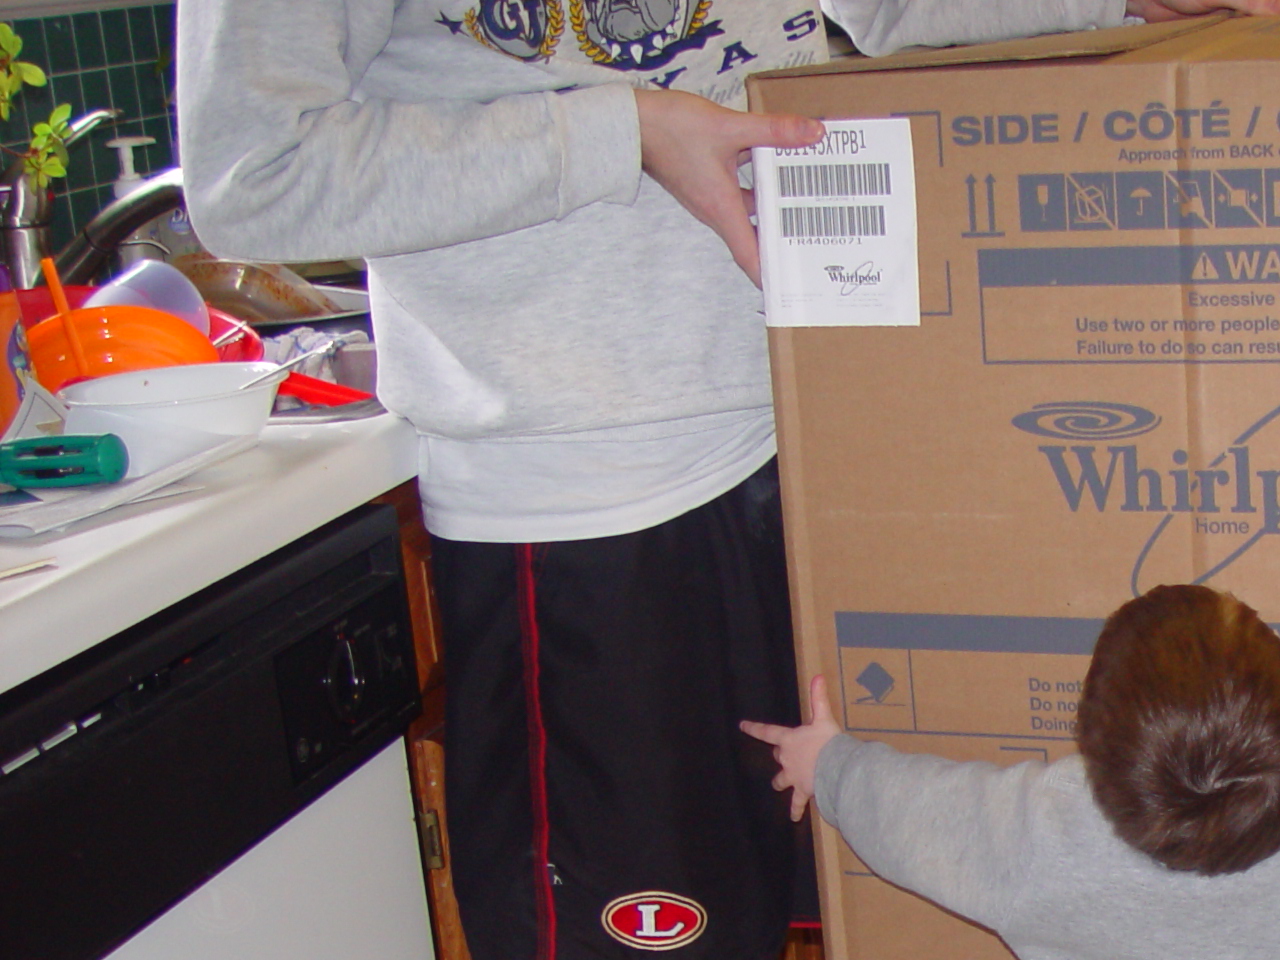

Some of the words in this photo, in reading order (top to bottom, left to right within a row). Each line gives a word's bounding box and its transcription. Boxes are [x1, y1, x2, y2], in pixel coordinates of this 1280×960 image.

[952, 113, 1059, 147] SIDE
[1073, 111, 1089, 142] /
[1103, 101, 1231, 142] CÔTÉ
[1246, 106, 1261, 138] /
[1118, 147, 1186, 163] Approach
[1192, 145, 1225, 160] from
[1230, 144, 1274, 159] BACK
[1188, 291, 1275, 307] Excessive
[1075, 317, 1108, 332] Use
[1113, 317, 1144, 332] two
[1150, 320, 1169, 332] or
[1173, 319, 1215, 331] more
[1221, 316, 1280, 334] people
[1077, 339, 1134, 355] Failure
[1138, 340, 1155, 355] to
[1161, 339, 1183, 355] do
[1187, 341, 1206, 354] so
[1212, 341, 1243, 354] can
[1196, 518, 1249, 534] Home
[1028, 678, 1051, 692] Do
[1056, 680, 1082, 693] not
[1030, 697, 1052, 711] Do
[1057, 701, 1078, 712] no
[636, 904, 685, 937] L
